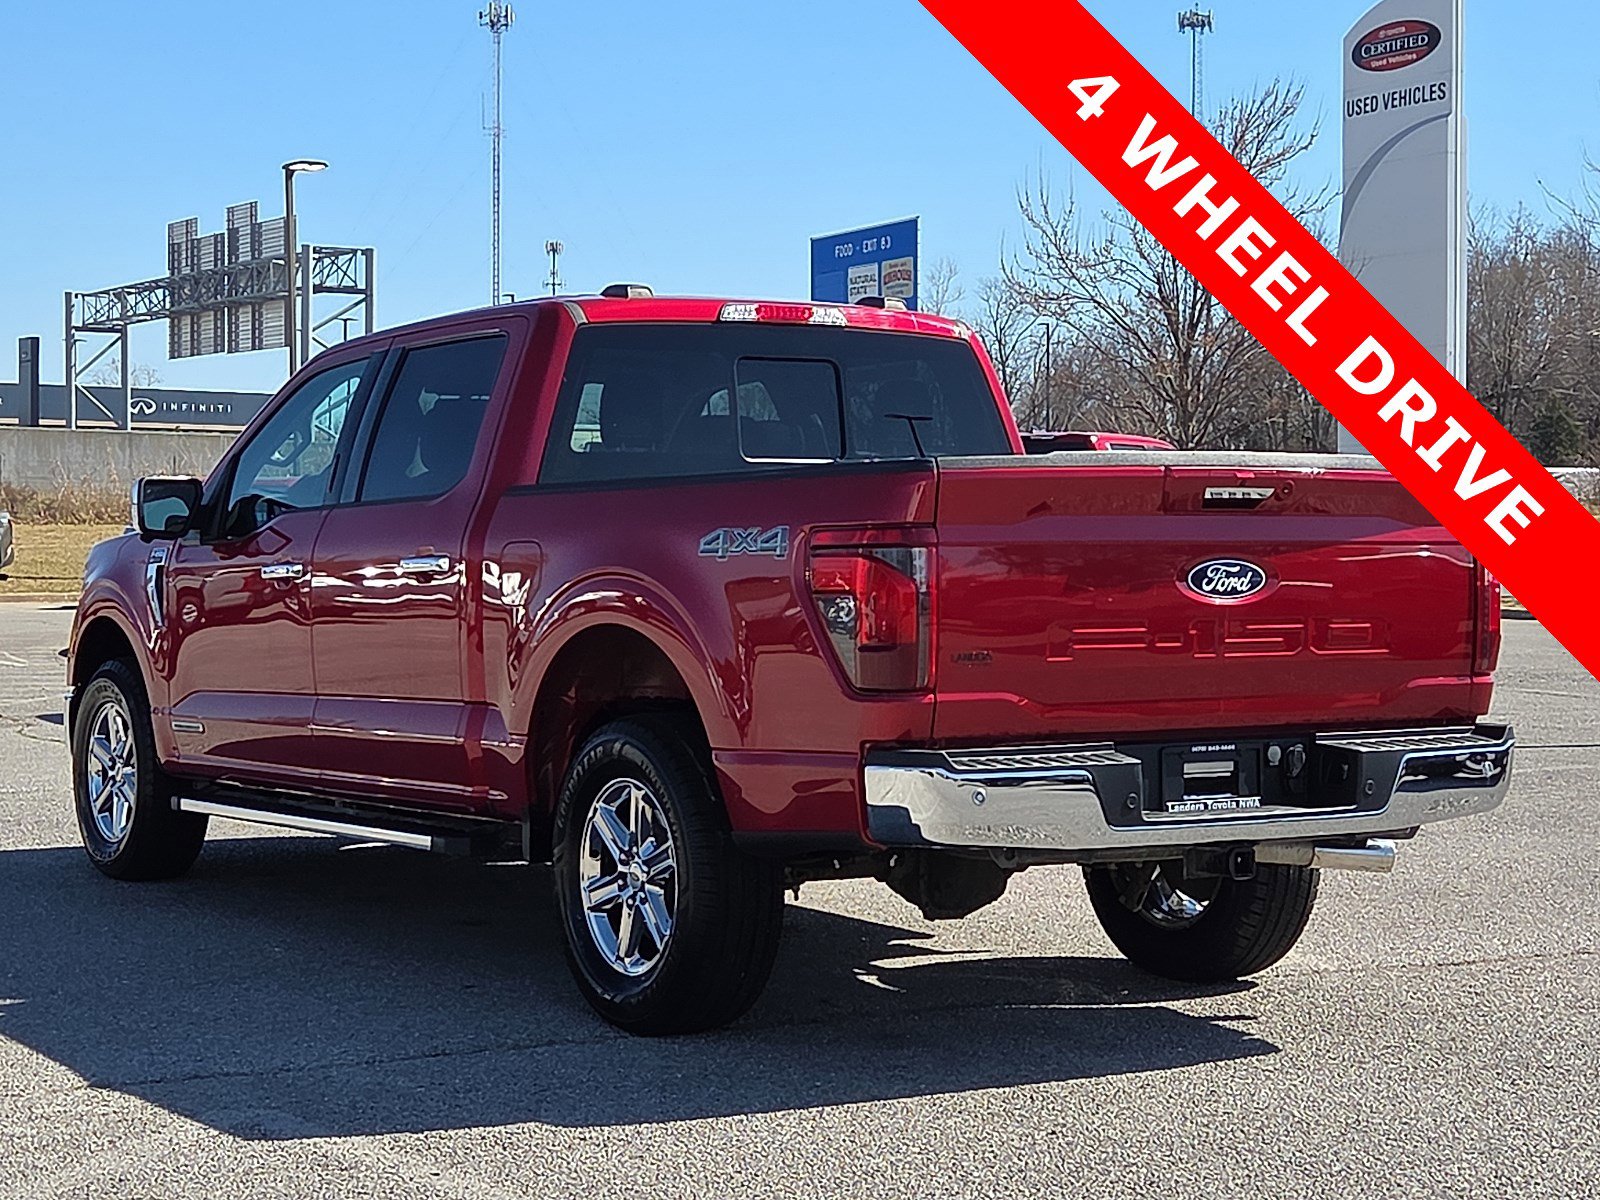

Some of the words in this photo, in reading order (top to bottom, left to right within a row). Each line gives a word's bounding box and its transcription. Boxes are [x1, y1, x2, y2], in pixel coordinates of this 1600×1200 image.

[1361, 34, 1428, 58] CERTIFIED
[1371, 58, 1387, 68] Used
[1389, 53, 1417, 64] Vehicles
[1346, 95, 1379, 118] USED
[1382, 82, 1447, 111] VEHICLES
[834, 243, 854, 258] FOOD
[862, 238, 878, 253] EXIT
[162, 402, 232, 413] INFINITI
[1201, 565, 1252, 594] Ford
[1046, 616, 1390, 662] F-150
[1207, 800, 1236, 811] Toyota
